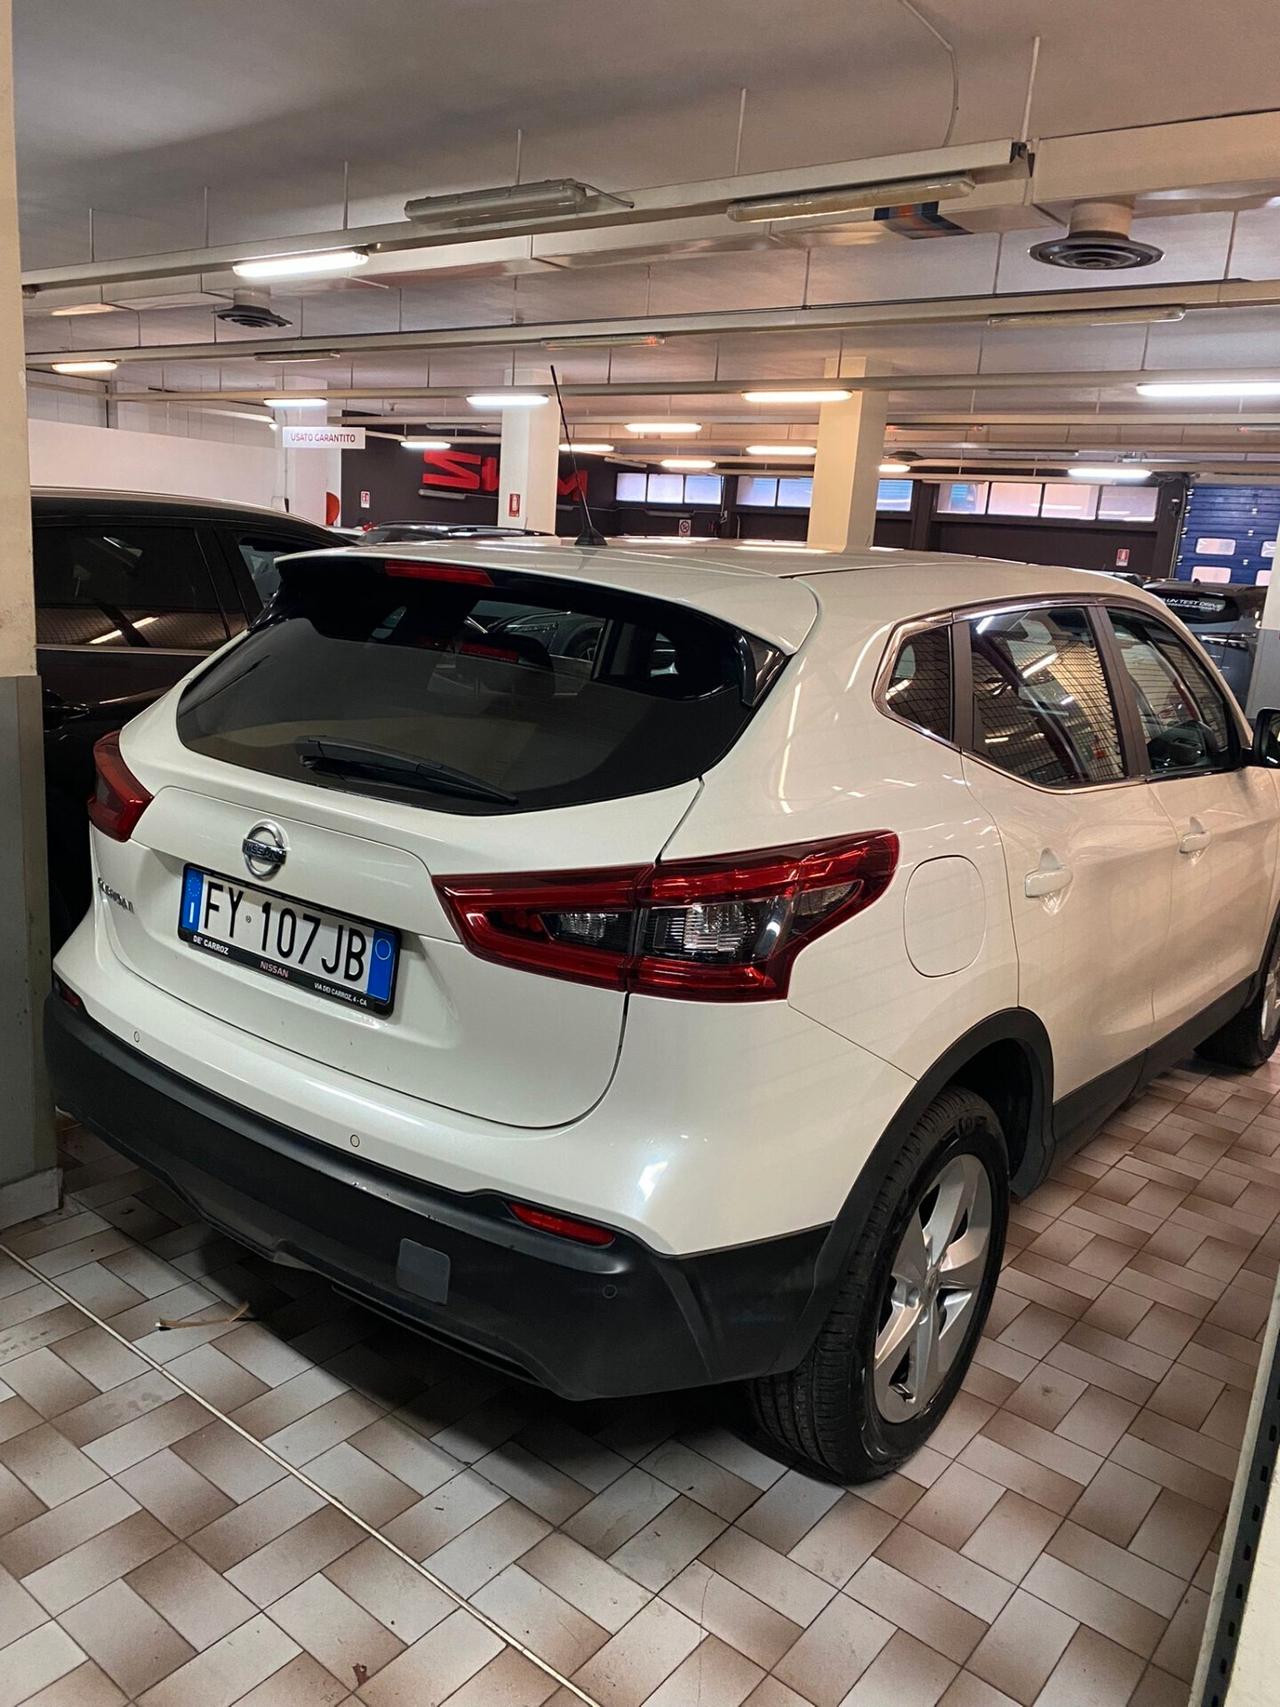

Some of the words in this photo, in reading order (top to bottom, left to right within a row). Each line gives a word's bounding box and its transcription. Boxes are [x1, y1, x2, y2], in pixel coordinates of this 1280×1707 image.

[290, 432, 314, 442] USATO
[314, 433, 356, 443] GARANTITO
[204, 881, 244, 938] FY
[203, 939, 229, 955] CARROZ
[260, 961, 289, 978] NISSAN
[314, 982, 323, 992] VIA
[360, 998, 367, 1006] CA
